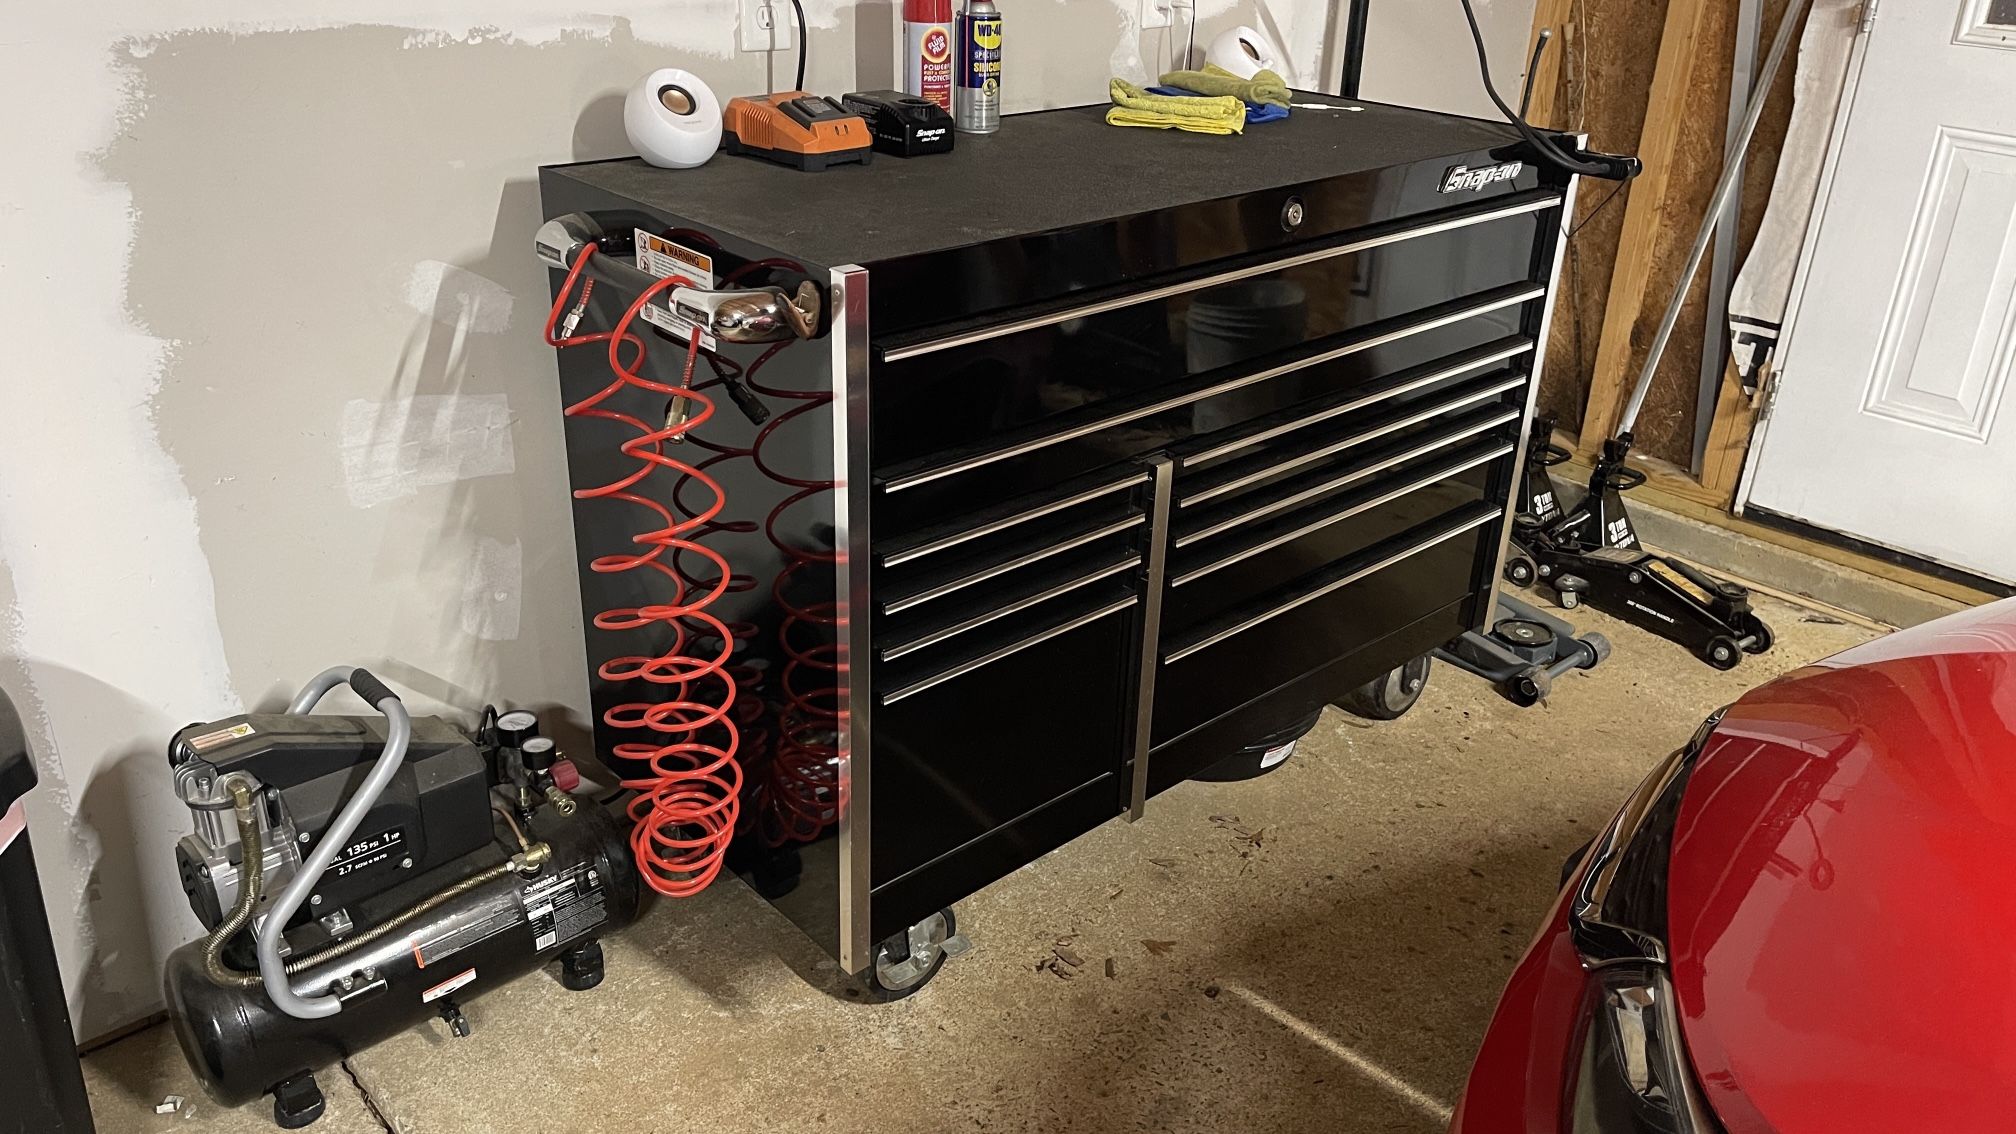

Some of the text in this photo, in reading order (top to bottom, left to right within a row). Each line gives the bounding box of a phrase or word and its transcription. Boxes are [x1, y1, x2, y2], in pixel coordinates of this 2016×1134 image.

[928, 36, 944, 49] FLUID
[933, 42, 945, 55] FILM
[1443, 162, 1522, 193] Snap-on
[667, 244, 699, 266] WARNING
[1533, 494, 1544, 515] 3
[1607, 521, 1618, 543] 3
[347, 842, 368, 856] 135
[369, 840, 379, 849] PSI
[383, 833, 389, 843] 1
[391, 832, 400, 840] HP
[339, 865, 352, 875] 2.7
[532, 875, 557, 890] HUSKY
